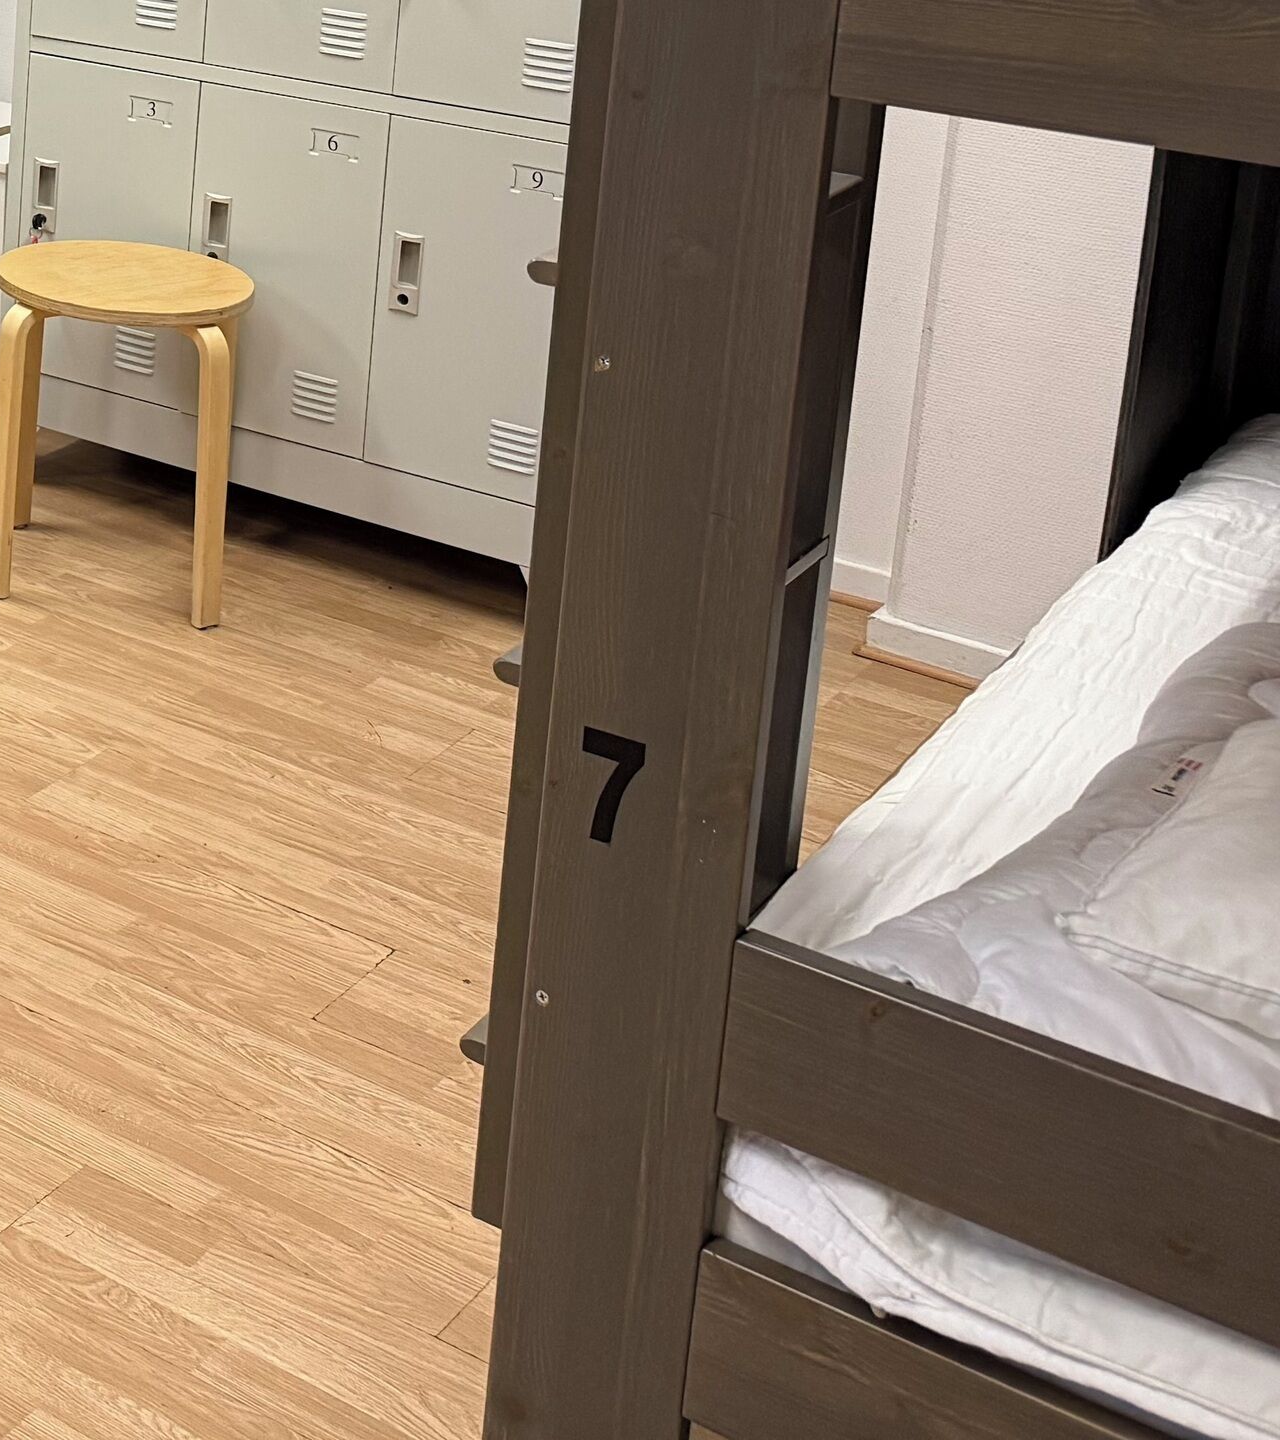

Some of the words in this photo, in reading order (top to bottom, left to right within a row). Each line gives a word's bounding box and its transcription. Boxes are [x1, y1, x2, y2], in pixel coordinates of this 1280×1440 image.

[146, 101, 156, 118] 3
[327, 134, 338, 152] 6
[532, 171, 543, 189] 9
[582, 726, 646, 846] 7
